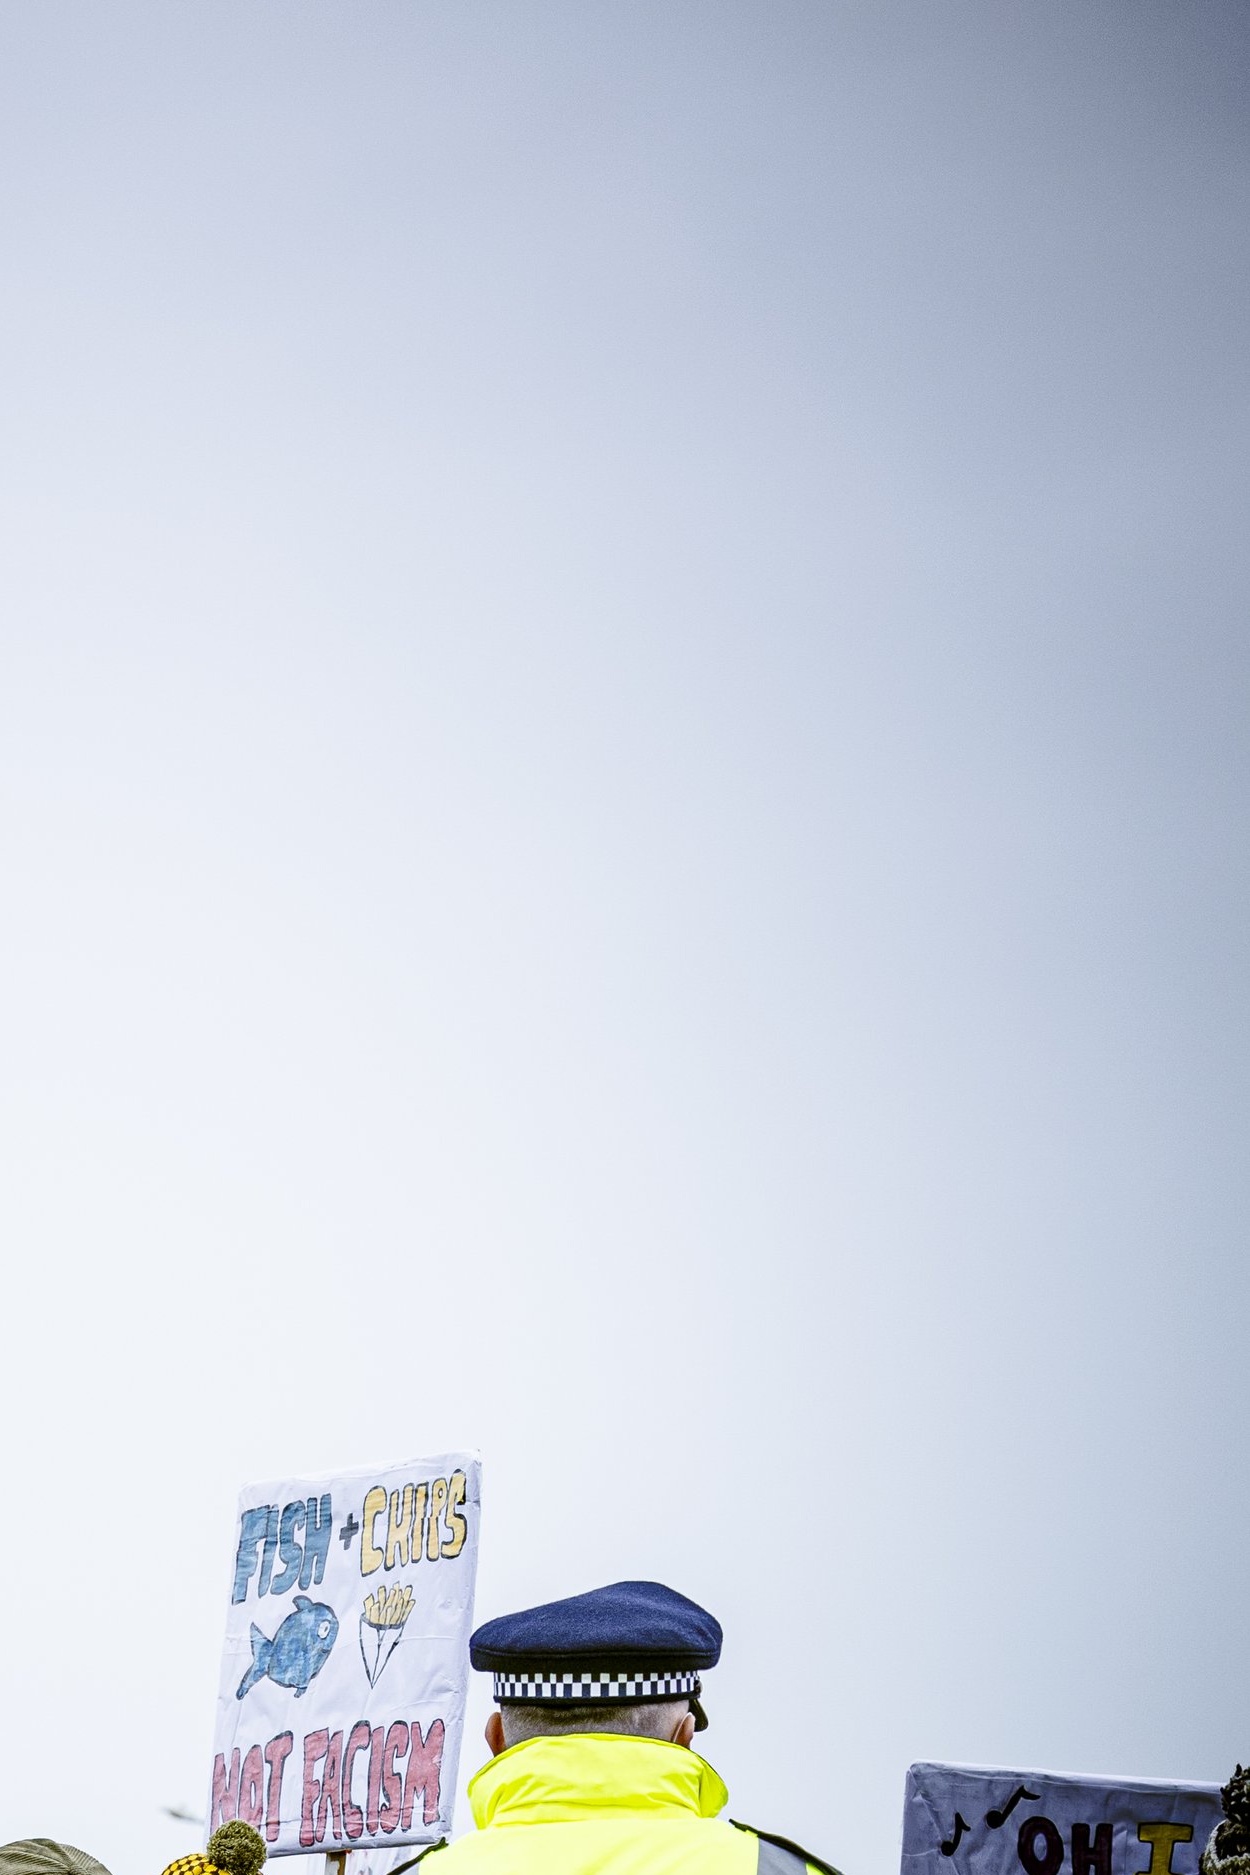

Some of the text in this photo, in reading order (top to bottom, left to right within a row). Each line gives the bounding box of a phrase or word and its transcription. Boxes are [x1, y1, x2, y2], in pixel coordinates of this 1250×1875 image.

[231, 1468, 467, 1605] FISH + CHIPS
[210, 1718, 445, 1847] NOT FACISM
